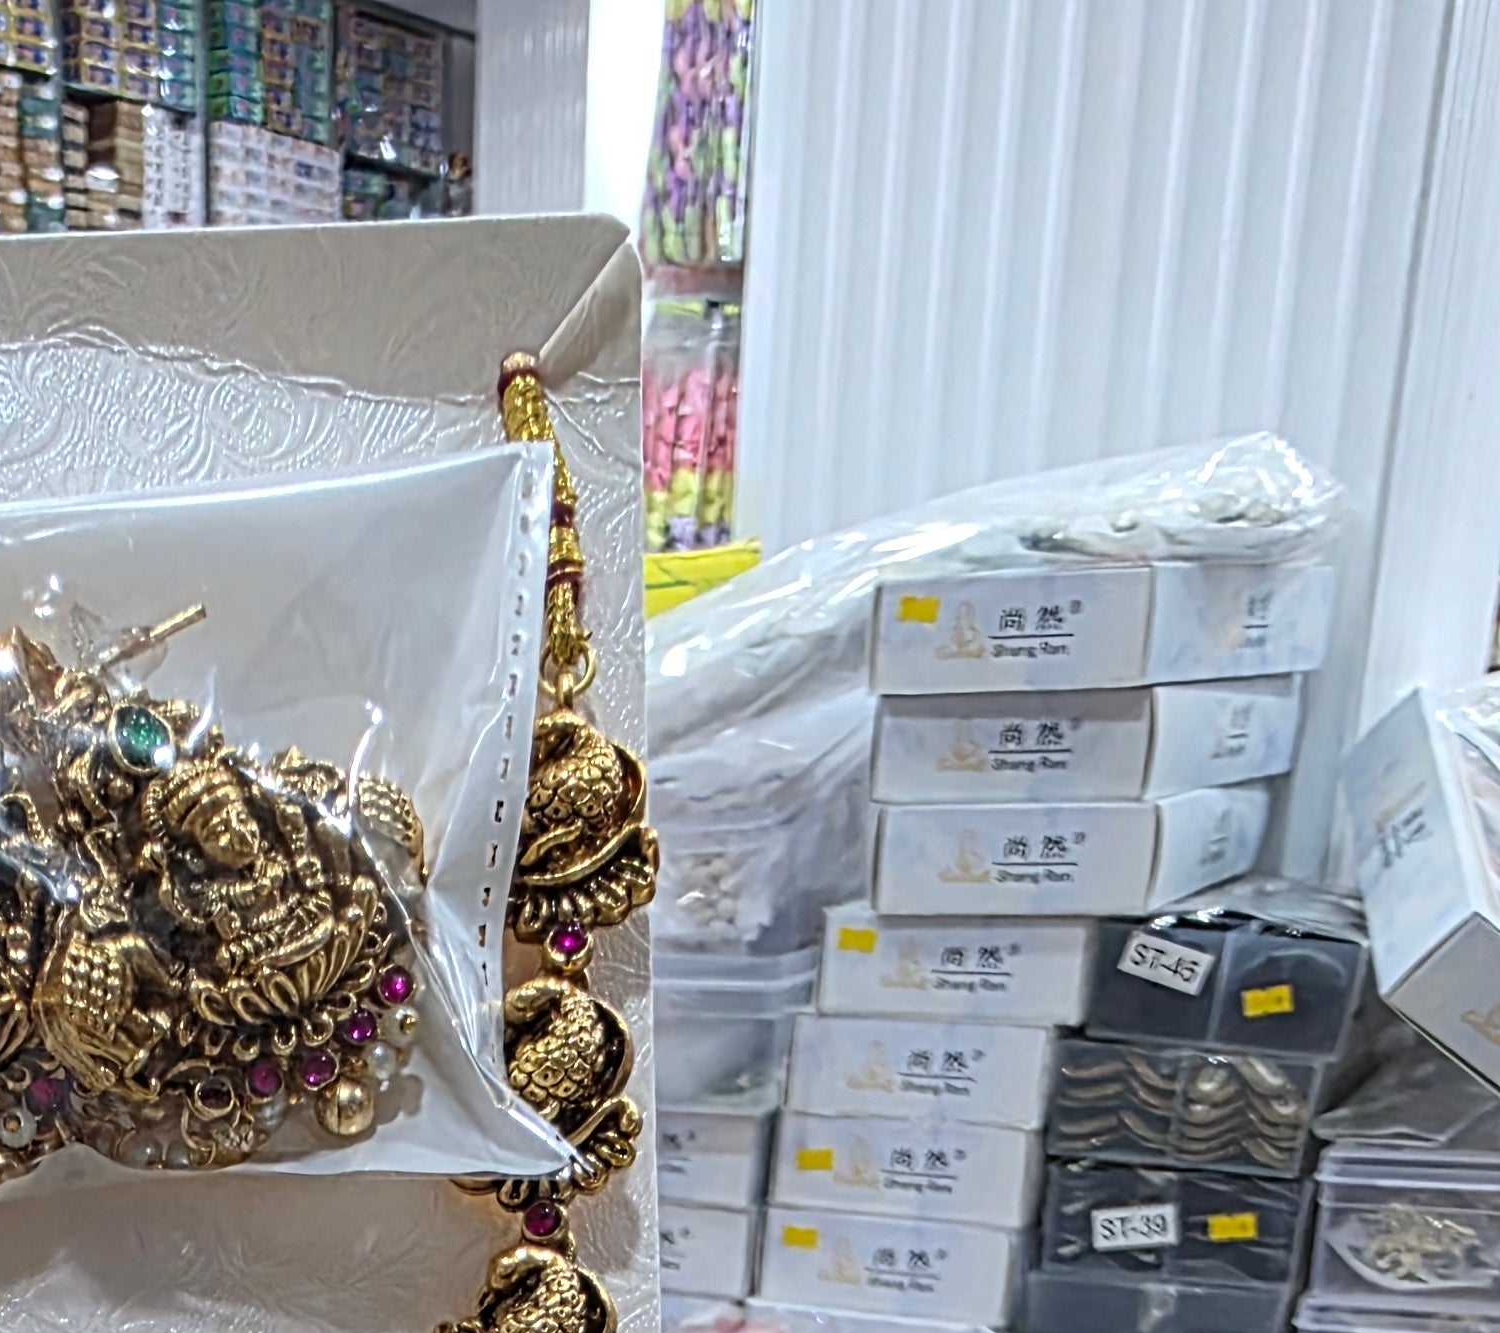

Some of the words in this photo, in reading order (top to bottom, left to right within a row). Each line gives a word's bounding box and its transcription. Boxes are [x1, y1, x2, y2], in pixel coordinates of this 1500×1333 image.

[999, 605, 1064, 631] 尚然
[1000, 722, 1065, 746] 尚然
[1003, 835, 1068, 860] 尚然
